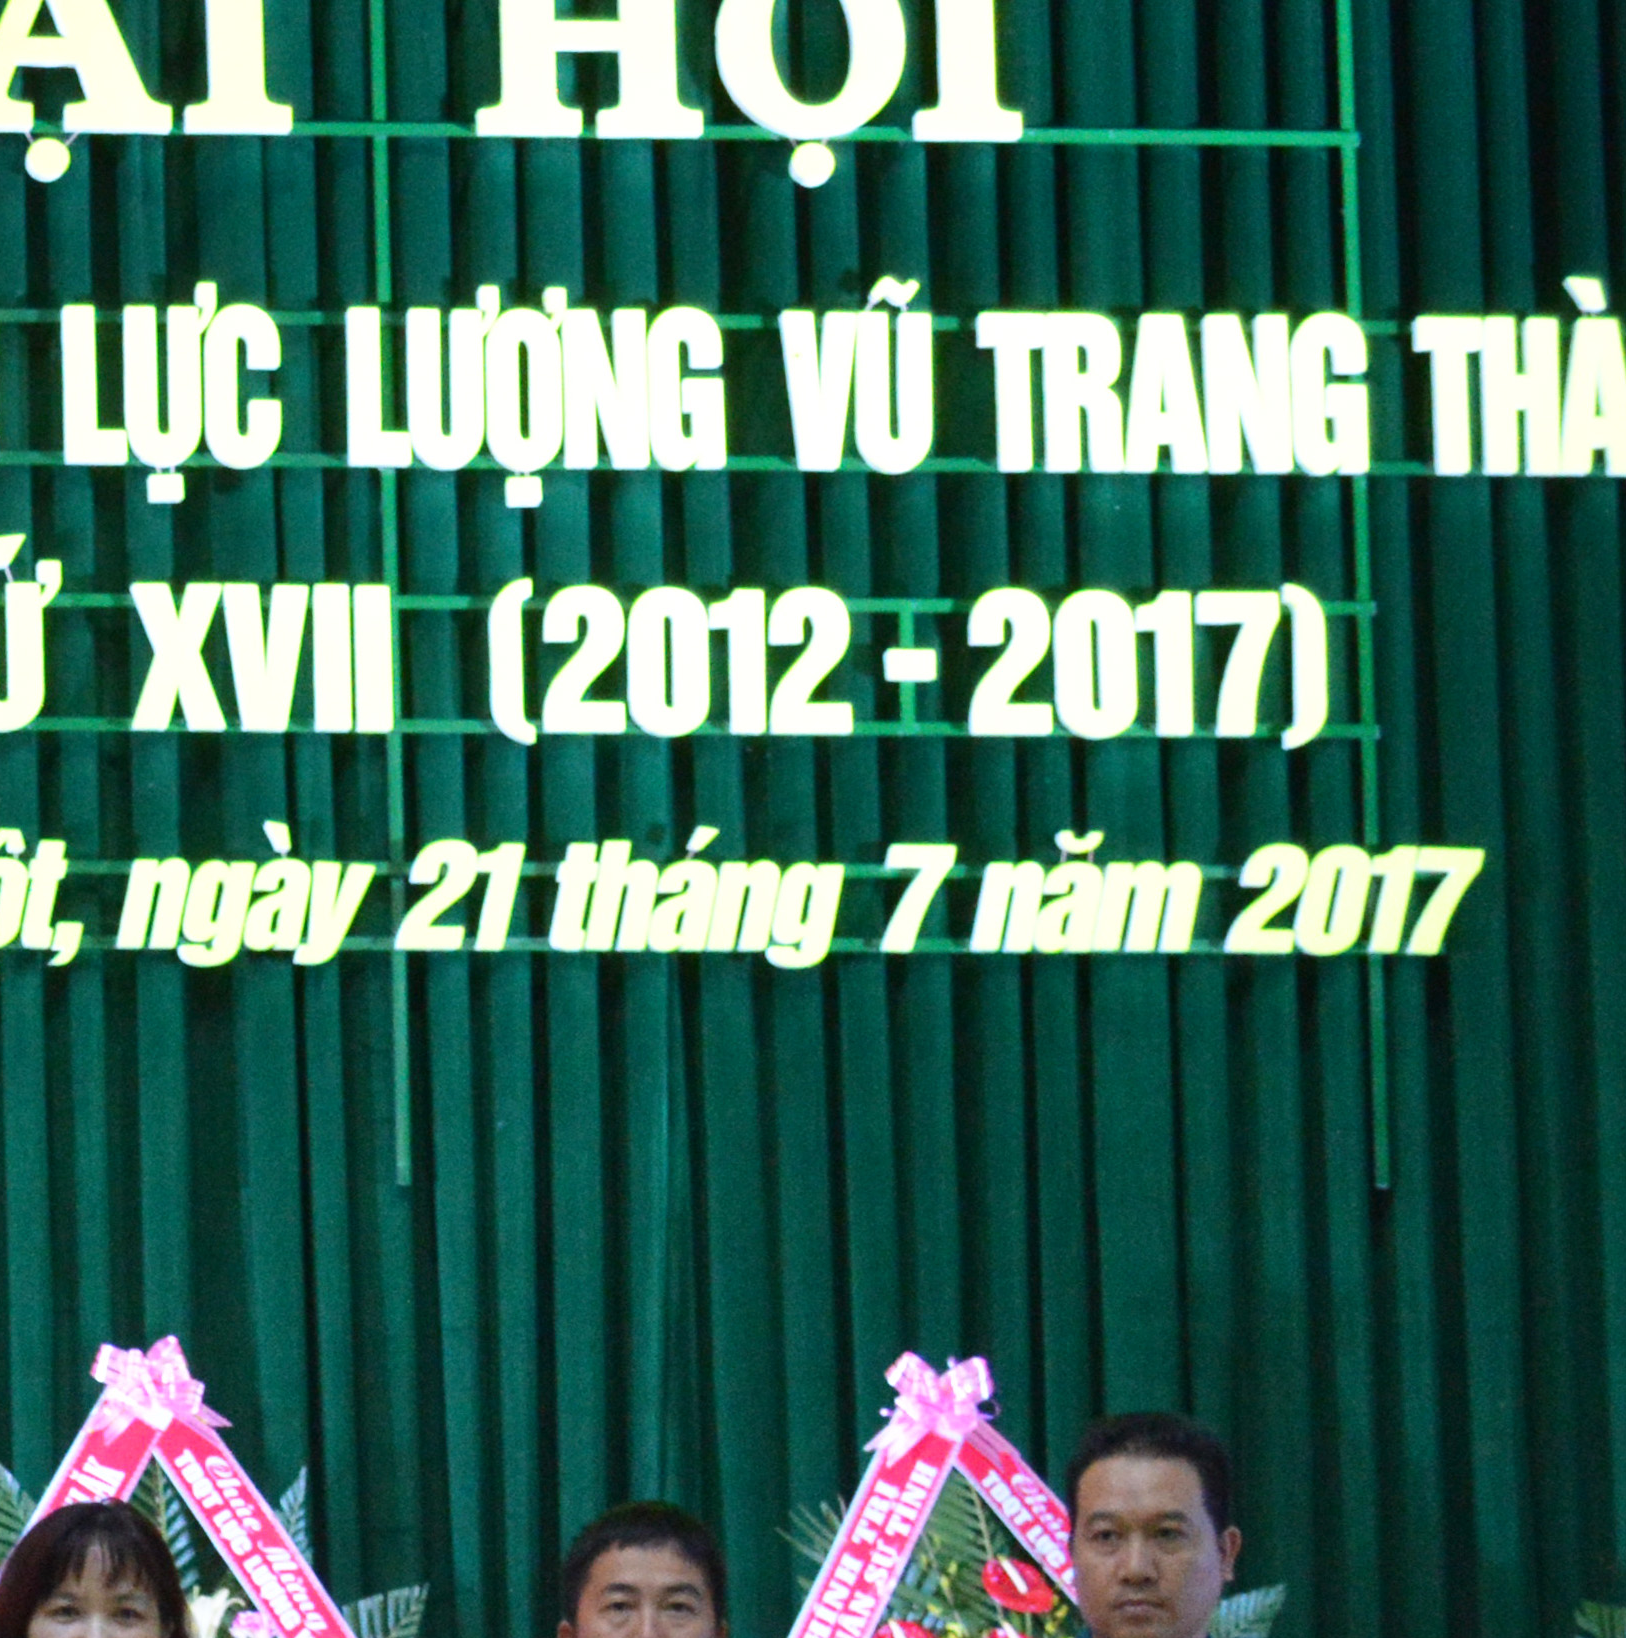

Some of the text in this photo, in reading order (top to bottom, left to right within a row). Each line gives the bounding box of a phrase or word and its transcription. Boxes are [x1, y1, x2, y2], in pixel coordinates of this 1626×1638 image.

[59, 281, 283, 505] LỰC
[344, 283, 729, 509] LƯỢNG
[777, 275, 935, 476] VŨ
[974, 310, 1371, 478] TRANG
[128, 581, 395, 735] XVII
[114, 819, 377, 968] ngày
[393, 838, 526, 953] 21
[547, 825, 846, 970] tháng
[880, 842, 958, 954] 7
[969, 829, 1203, 954] năm
[1223, 843, 1484, 957] 2017
[204, 1455, 262, 1533] Chúc
[257, 1540, 328, 1633] Mừng
